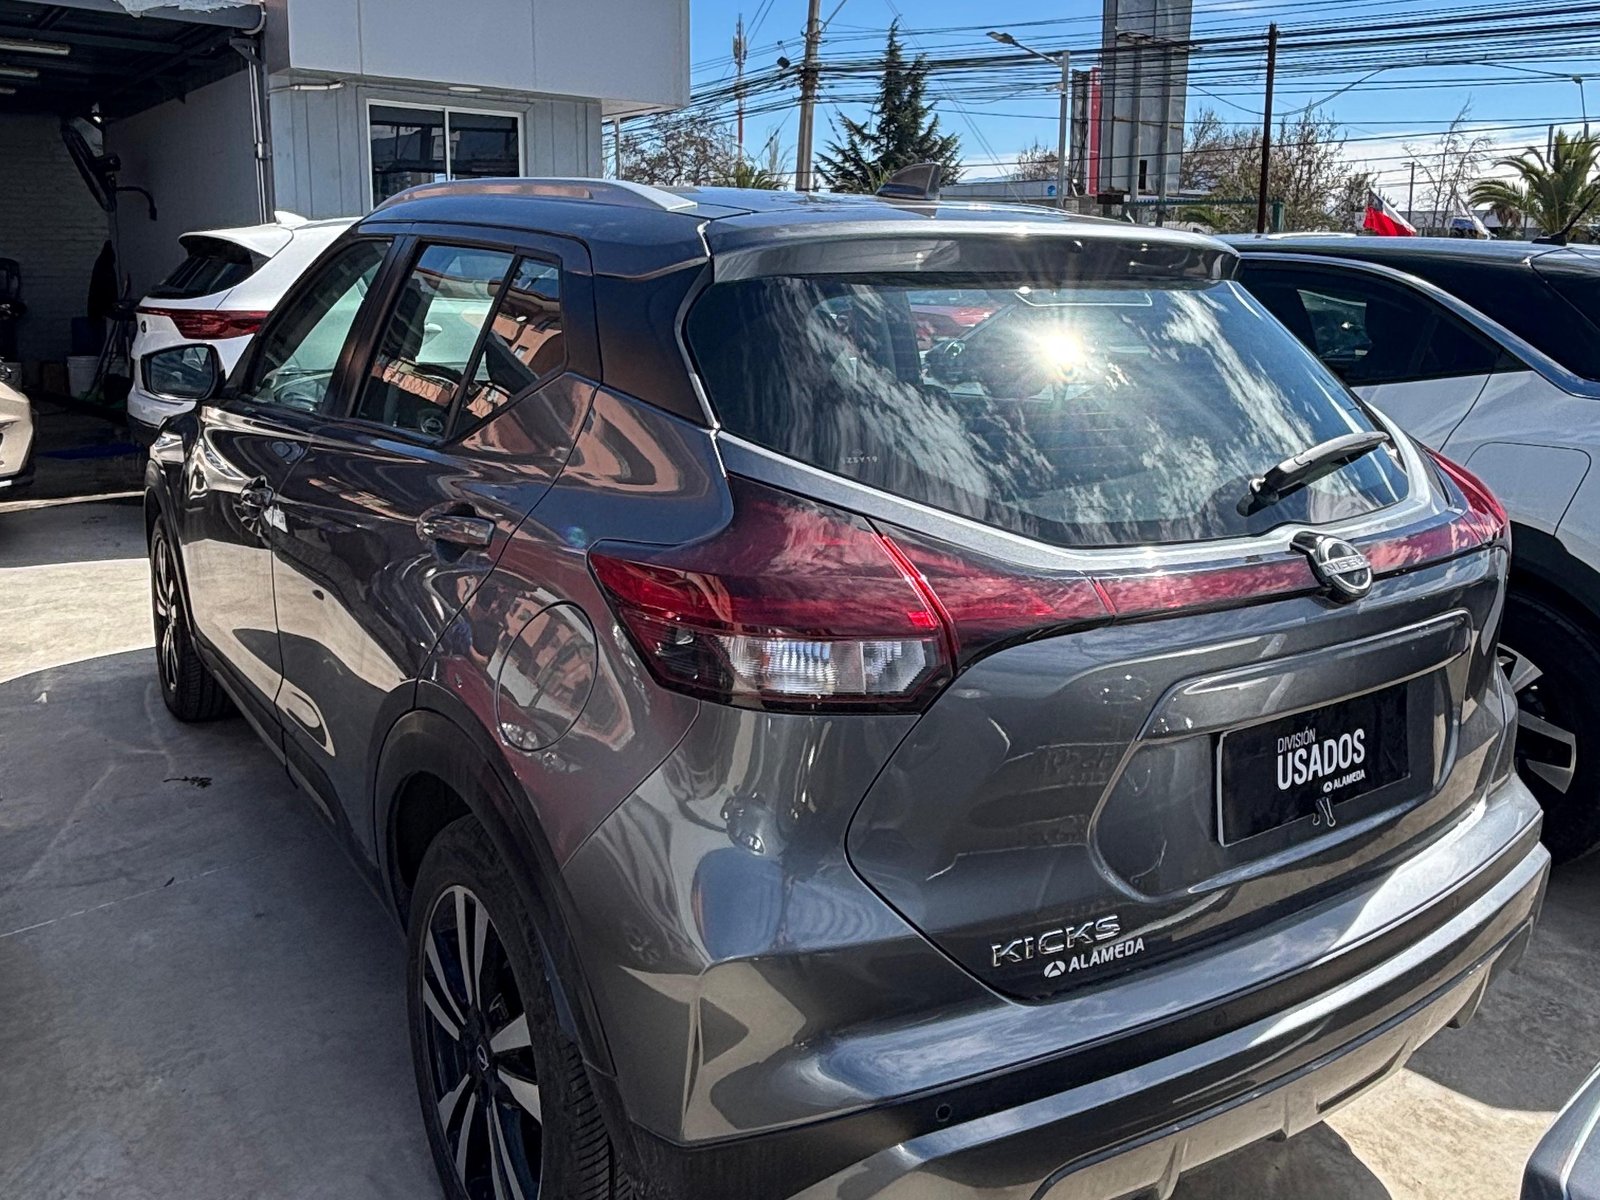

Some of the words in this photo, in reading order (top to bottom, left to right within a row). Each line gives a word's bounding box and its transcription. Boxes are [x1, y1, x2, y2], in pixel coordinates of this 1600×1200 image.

[1277, 726, 1316, 754] DIVISIÓN
[1277, 728, 1365, 790] USADOS
[1333, 769, 1365, 790] ALAMEDA
[992, 915, 1120, 967] KICKS
[1068, 938, 1144, 972] ALAMEDA
